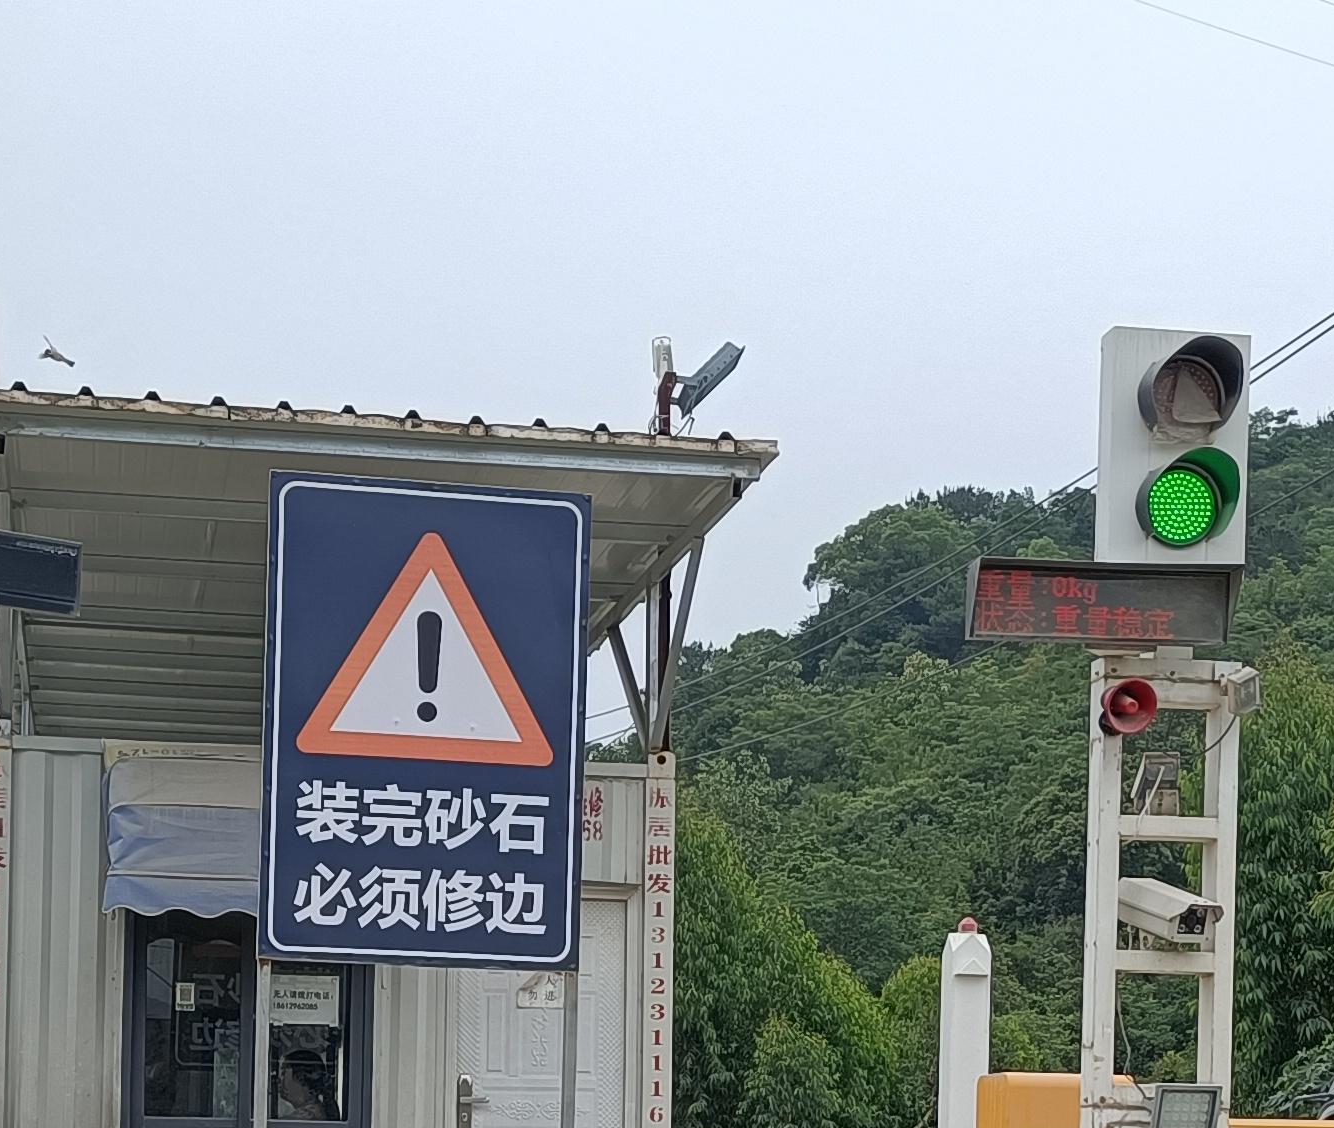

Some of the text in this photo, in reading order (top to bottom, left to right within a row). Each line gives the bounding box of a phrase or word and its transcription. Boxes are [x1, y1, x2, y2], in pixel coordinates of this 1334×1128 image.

[295, 779, 550, 855] 装完砂石
[293, 862, 547, 935] 必须修边
